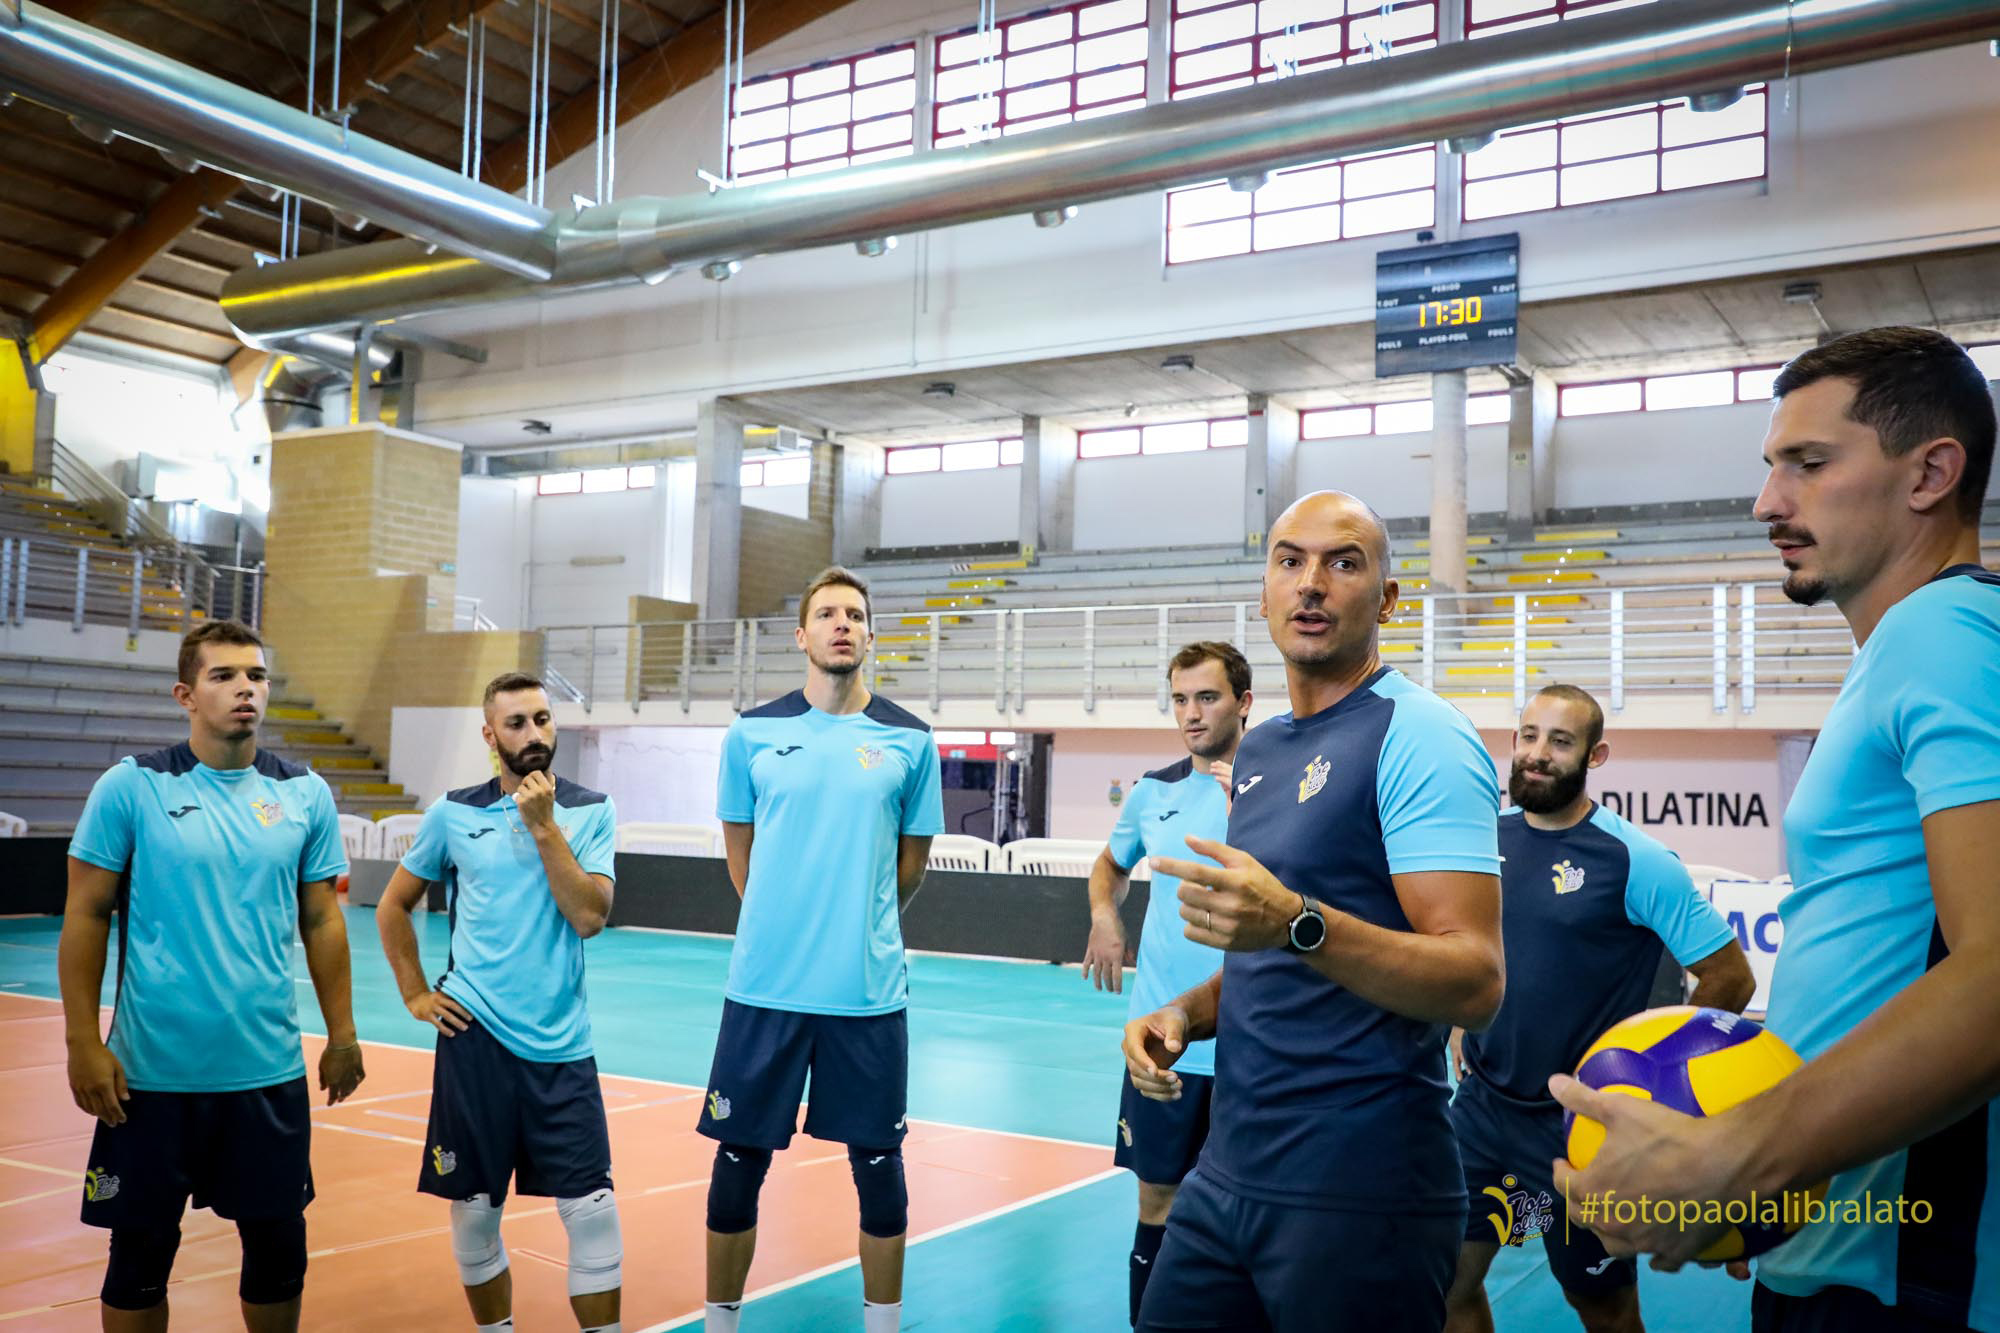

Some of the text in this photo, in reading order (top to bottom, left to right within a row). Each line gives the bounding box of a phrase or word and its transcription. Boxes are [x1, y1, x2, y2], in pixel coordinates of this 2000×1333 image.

[1431, 282, 1461, 293] PERIOD
[1419, 296, 1482, 329] 17:30
[1488, 326, 1514, 337] FOULS
[1377, 340, 1402, 350] FOULS
[1642, 791, 1769, 828] LATINA
